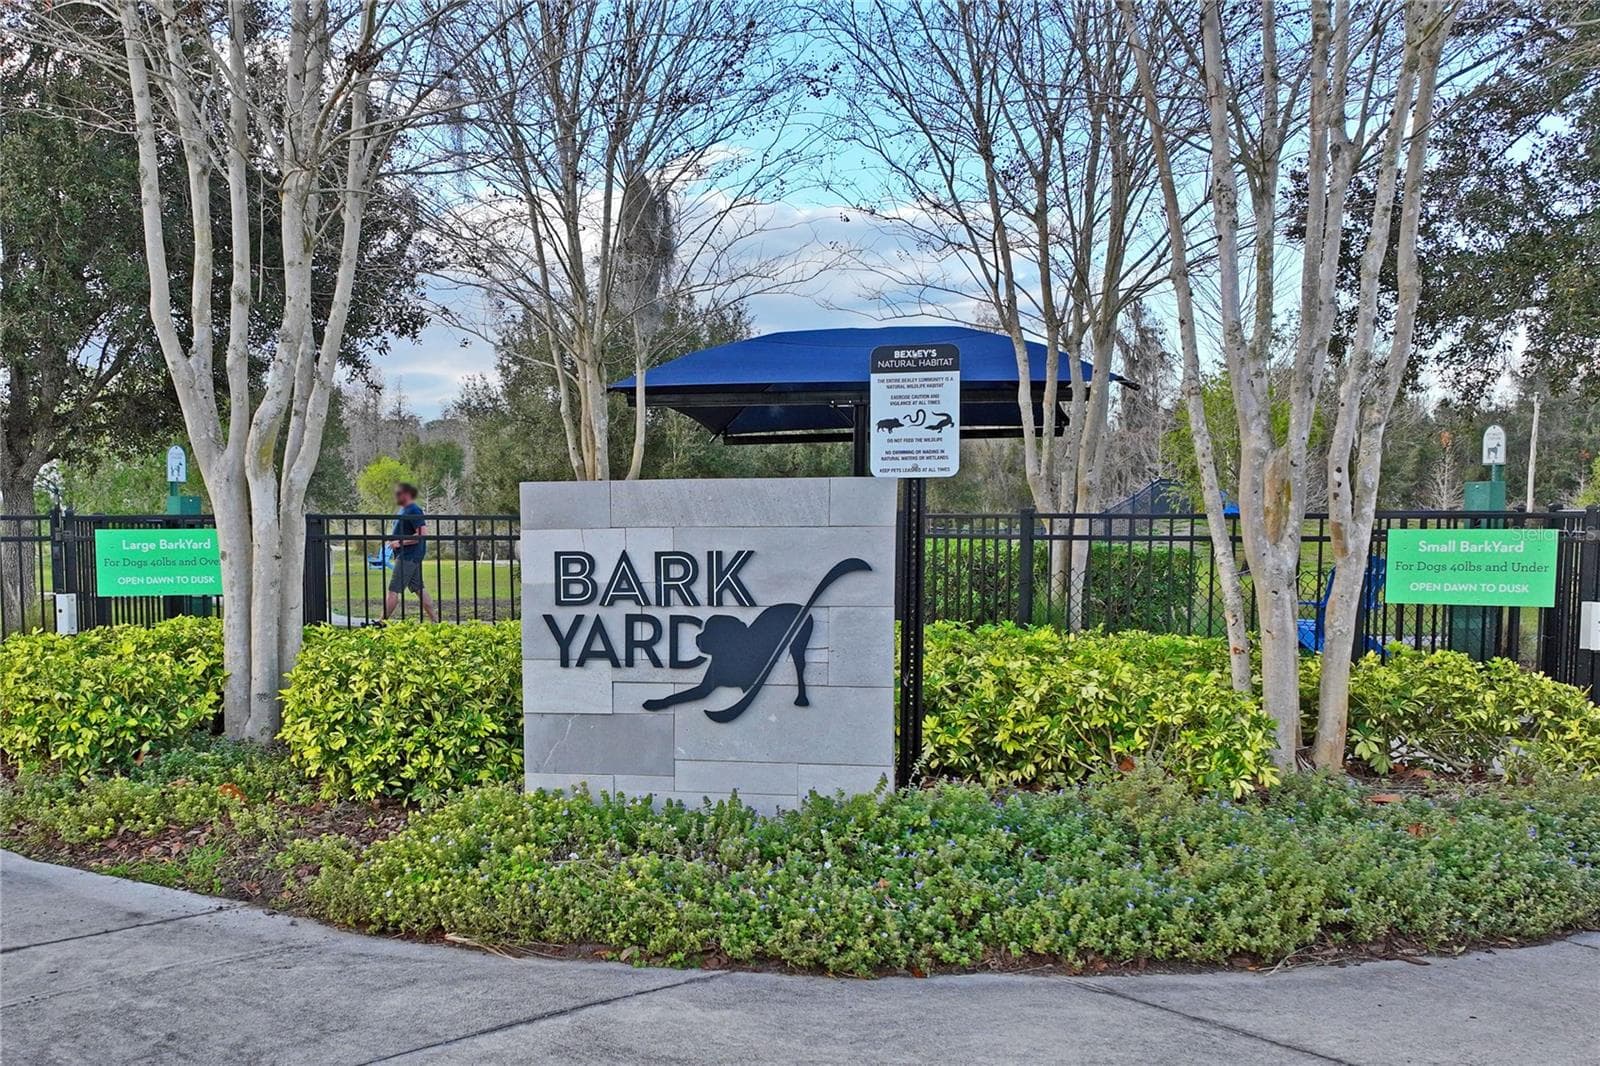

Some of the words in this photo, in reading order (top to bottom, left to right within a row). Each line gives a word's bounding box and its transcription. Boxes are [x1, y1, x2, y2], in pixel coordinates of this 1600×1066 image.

[894, 349, 937, 358] BEXLEY'S
[878, 360, 916, 368] NATURAL
[919, 358, 953, 366] HABITAT
[122, 540, 156, 552] Large
[160, 538, 211, 549] BarkYard
[1418, 540, 1456, 553] Small
[1460, 541, 1525, 553] BarkYard
[104, 558, 120, 567] For
[123, 558, 148, 568] Dogs
[150, 557, 176, 567] 40lbs
[179, 557, 196, 566] and
[1395, 561, 1414, 571] For
[1417, 562, 1447, 574] Dogs
[1450, 561, 1482, 573] 40lbs
[1485, 562, 1508, 572] and
[1511, 562, 1549, 573] Under
[118, 576, 145, 585] OPEN
[176, 576, 189, 584] TO
[554, 550, 757, 607] BARK
[1410, 583, 1441, 591] OPEN
[1444, 583, 1478, 592] DAWN
[1480, 584, 1495, 592] TO
[1499, 584, 1529, 593] DUSK
[542, 614, 708, 669] YARD
